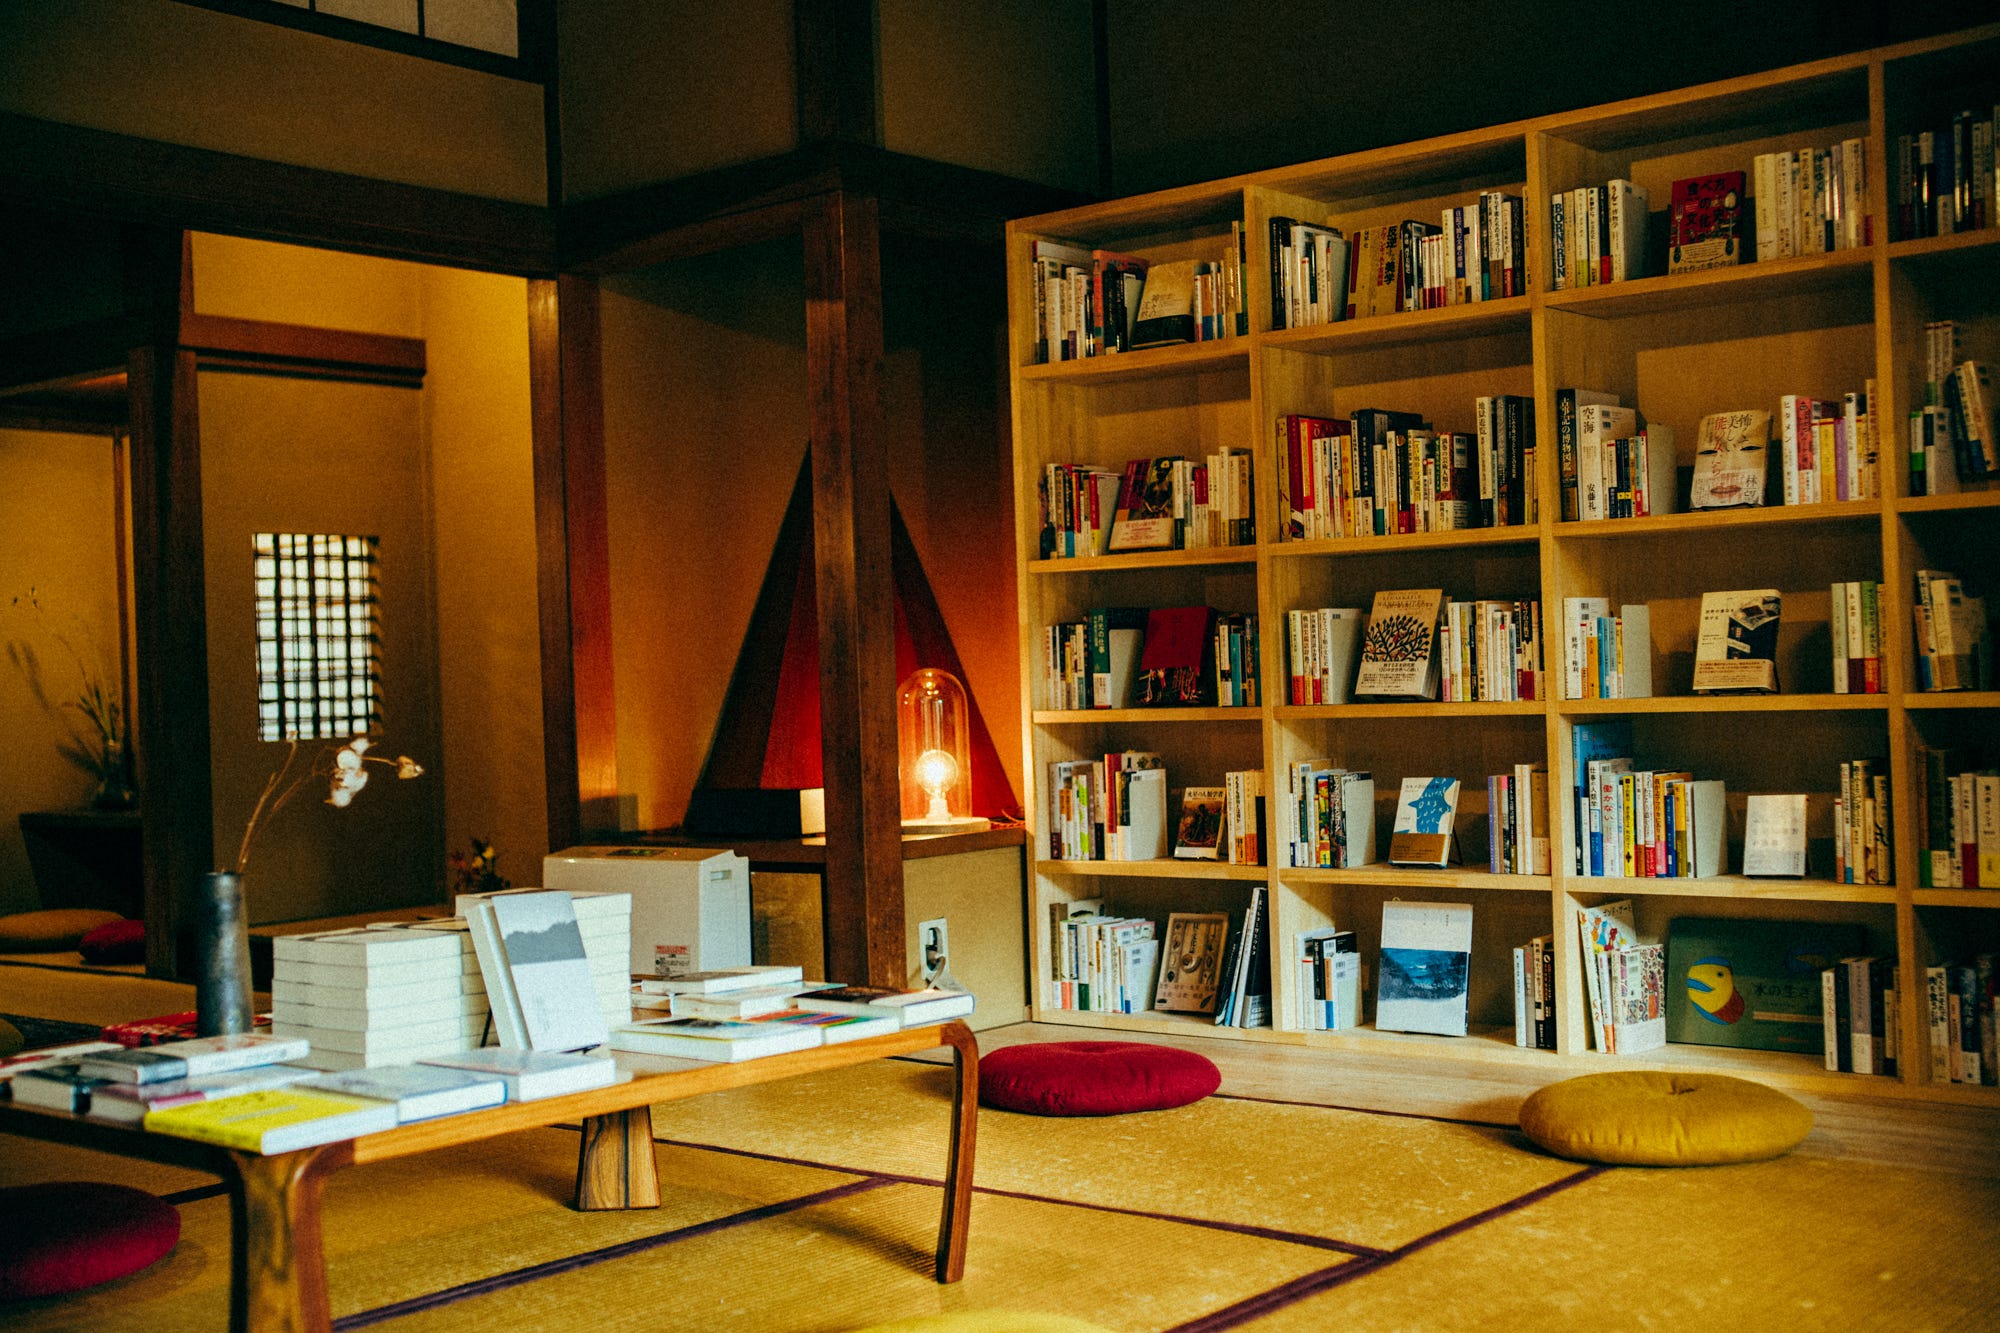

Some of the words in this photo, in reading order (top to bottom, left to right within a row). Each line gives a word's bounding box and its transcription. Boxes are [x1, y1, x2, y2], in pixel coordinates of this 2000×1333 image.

[1555, 203, 1564, 243] BORN
[1582, 407, 1595, 434] 空海
[1603, 784, 1613, 821] 働かない
